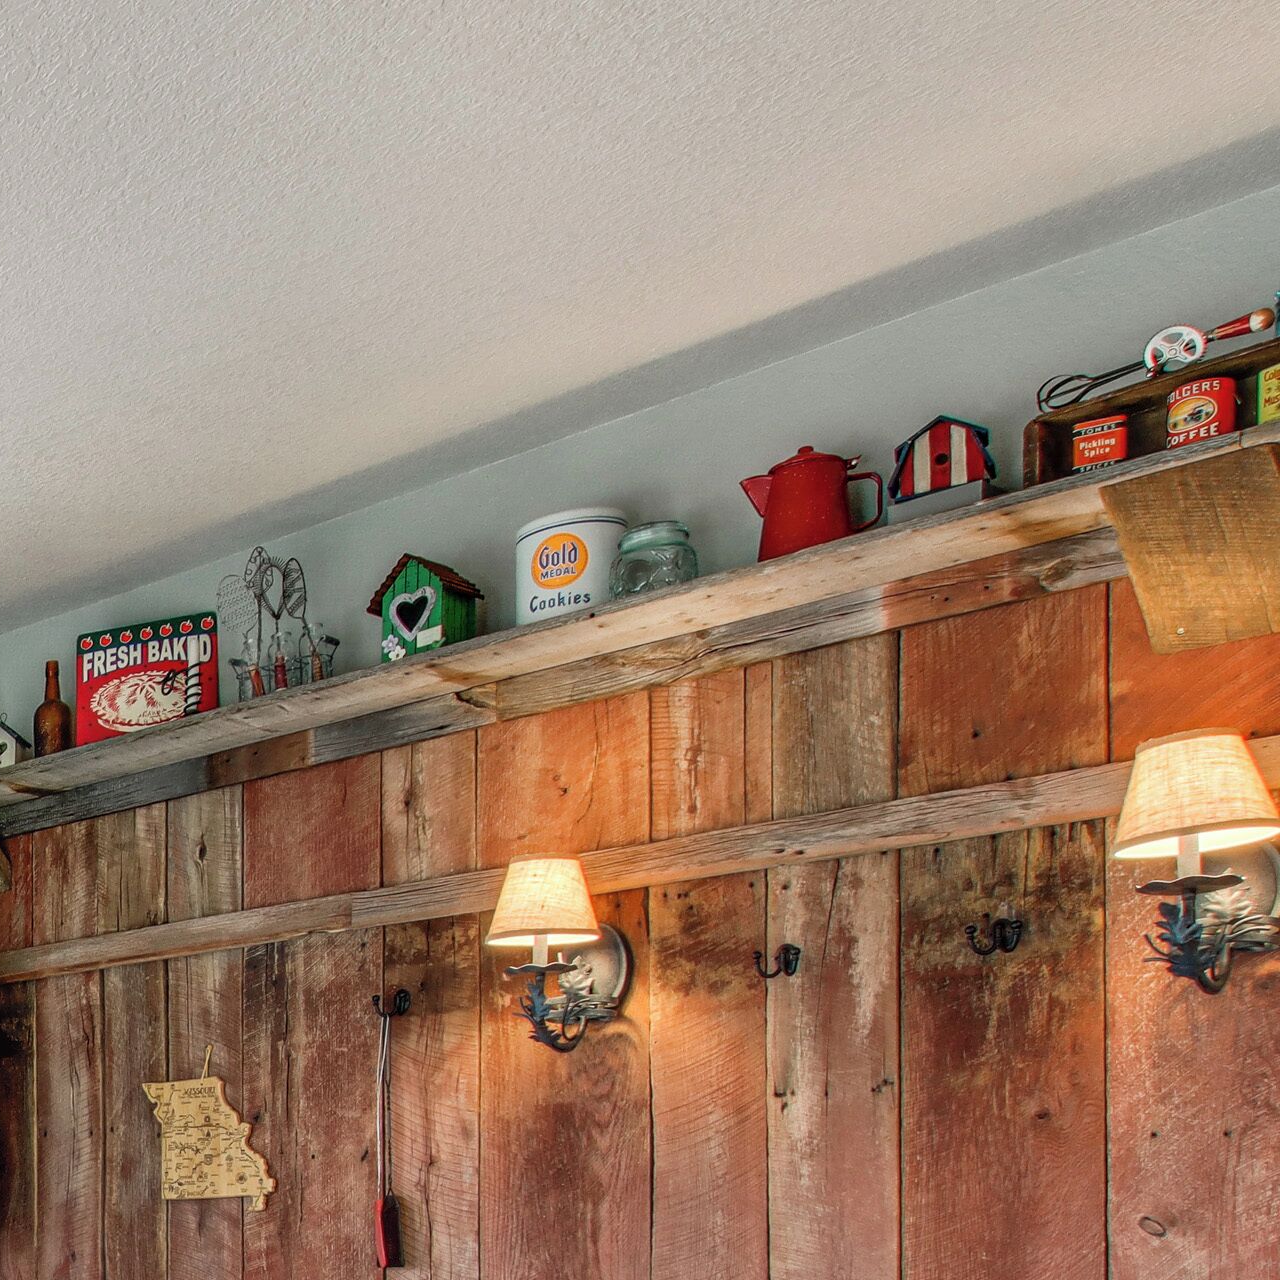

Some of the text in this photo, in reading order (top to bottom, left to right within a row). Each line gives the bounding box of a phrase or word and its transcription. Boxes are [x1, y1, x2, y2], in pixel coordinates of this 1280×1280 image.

[1079, 438, 1116, 450] Pickling
[1166, 422, 1220, 448] COFFEE
[1084, 447, 1111, 458] Spice
[538, 541, 579, 570] Gold
[540, 566, 577, 580] MEDAL
[529, 592, 591, 613] Cookies
[82, 643, 142, 683] FRESH
